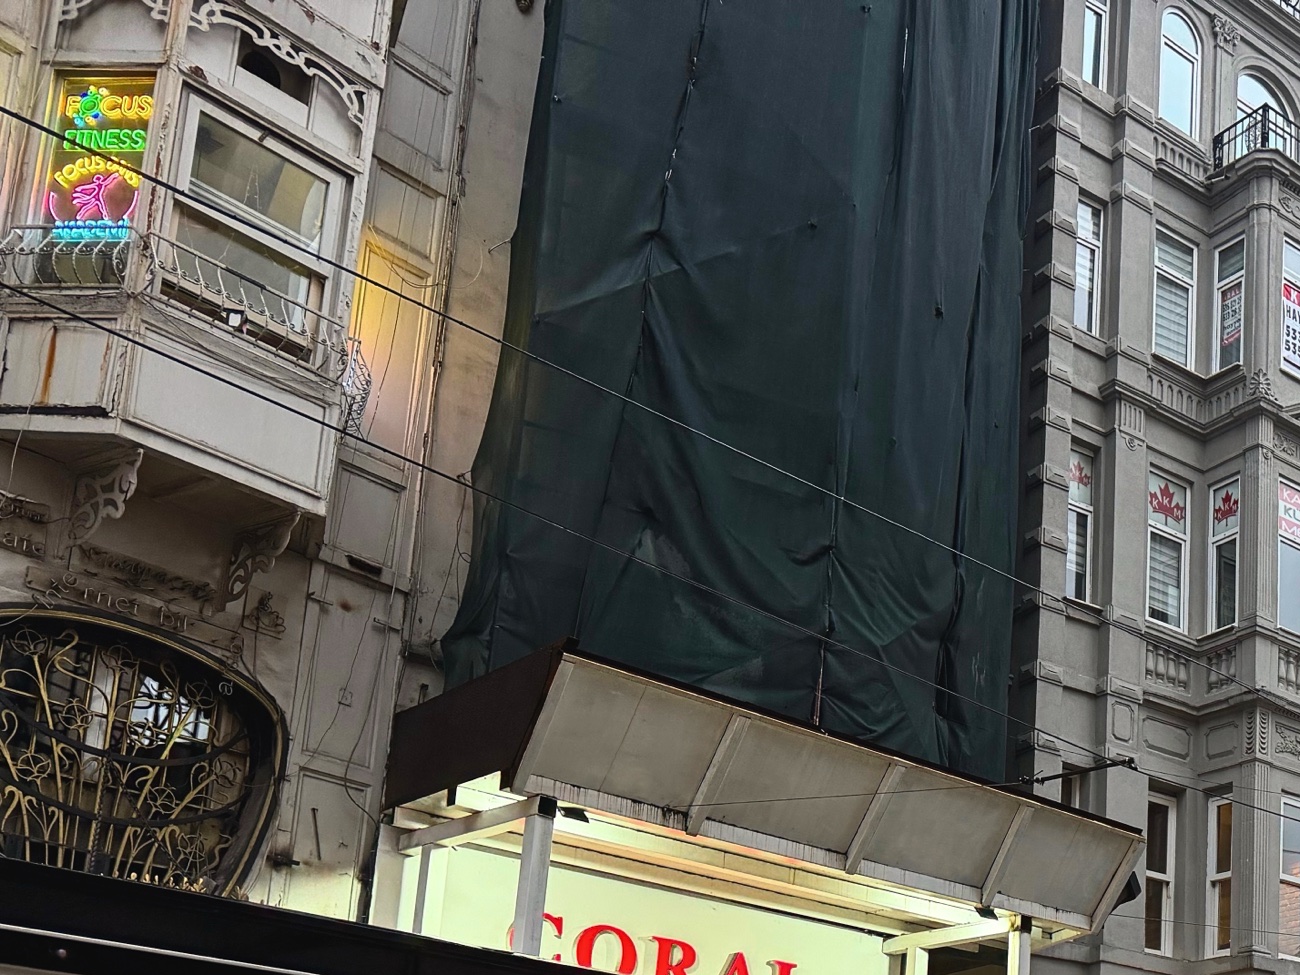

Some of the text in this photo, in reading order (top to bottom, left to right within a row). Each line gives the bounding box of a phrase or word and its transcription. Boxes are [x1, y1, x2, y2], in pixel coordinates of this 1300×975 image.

[65, 95, 154, 120] FOCUS
[63, 129, 147, 151] FITNESS
[54, 156, 107, 188] FOCUS
